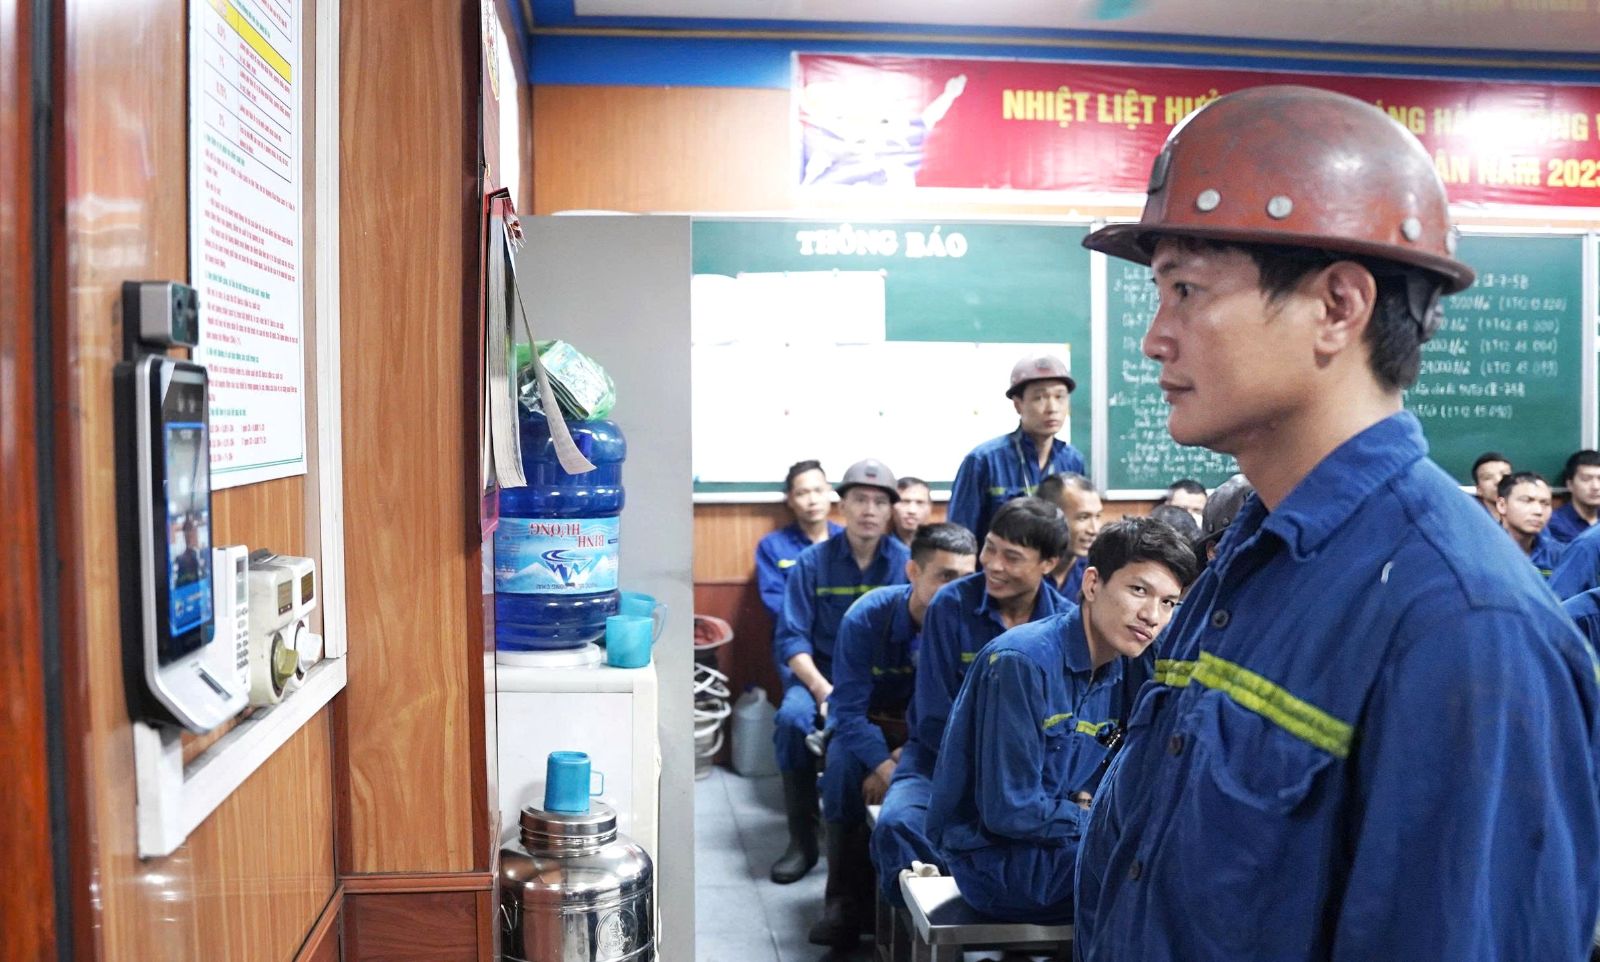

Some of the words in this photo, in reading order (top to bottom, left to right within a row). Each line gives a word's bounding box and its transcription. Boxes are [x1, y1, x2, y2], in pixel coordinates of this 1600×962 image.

[1002, 86, 1090, 128] NHIỆT
[1097, 89, 1156, 129] LIỆT
[796, 223, 899, 256] THÔNG
[905, 225, 968, 258] BÁO
